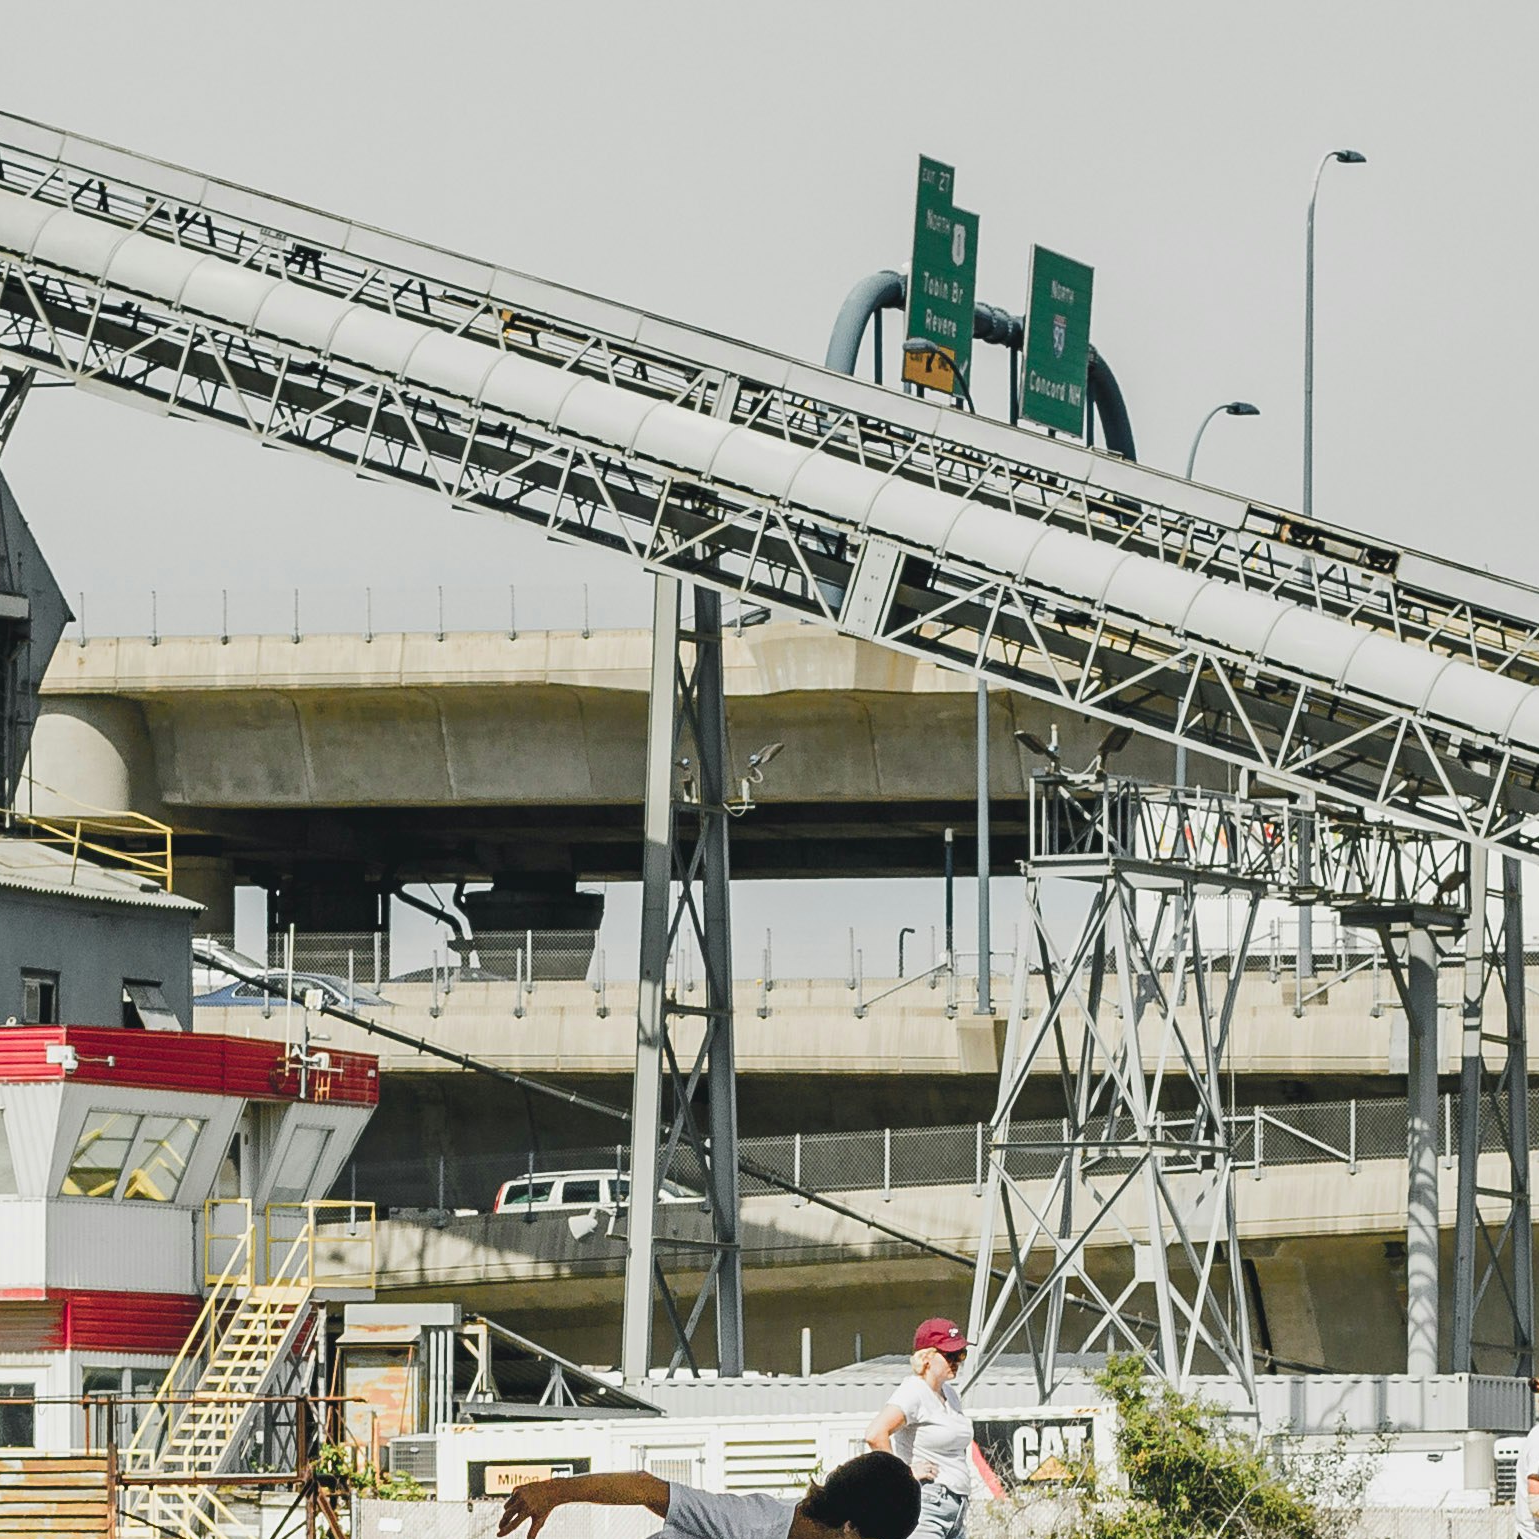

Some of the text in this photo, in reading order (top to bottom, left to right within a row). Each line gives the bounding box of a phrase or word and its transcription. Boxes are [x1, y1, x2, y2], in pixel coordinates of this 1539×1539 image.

[922, 167, 950, 192] EXIT 27
[924, 271, 964, 303] Tobin Br
[925, 308, 957, 338] Revere
[1030, 370, 1081, 406] Concord NH
[1013, 1425, 1087, 1480] CAT
[498, 1473, 540, 1485] Milton
